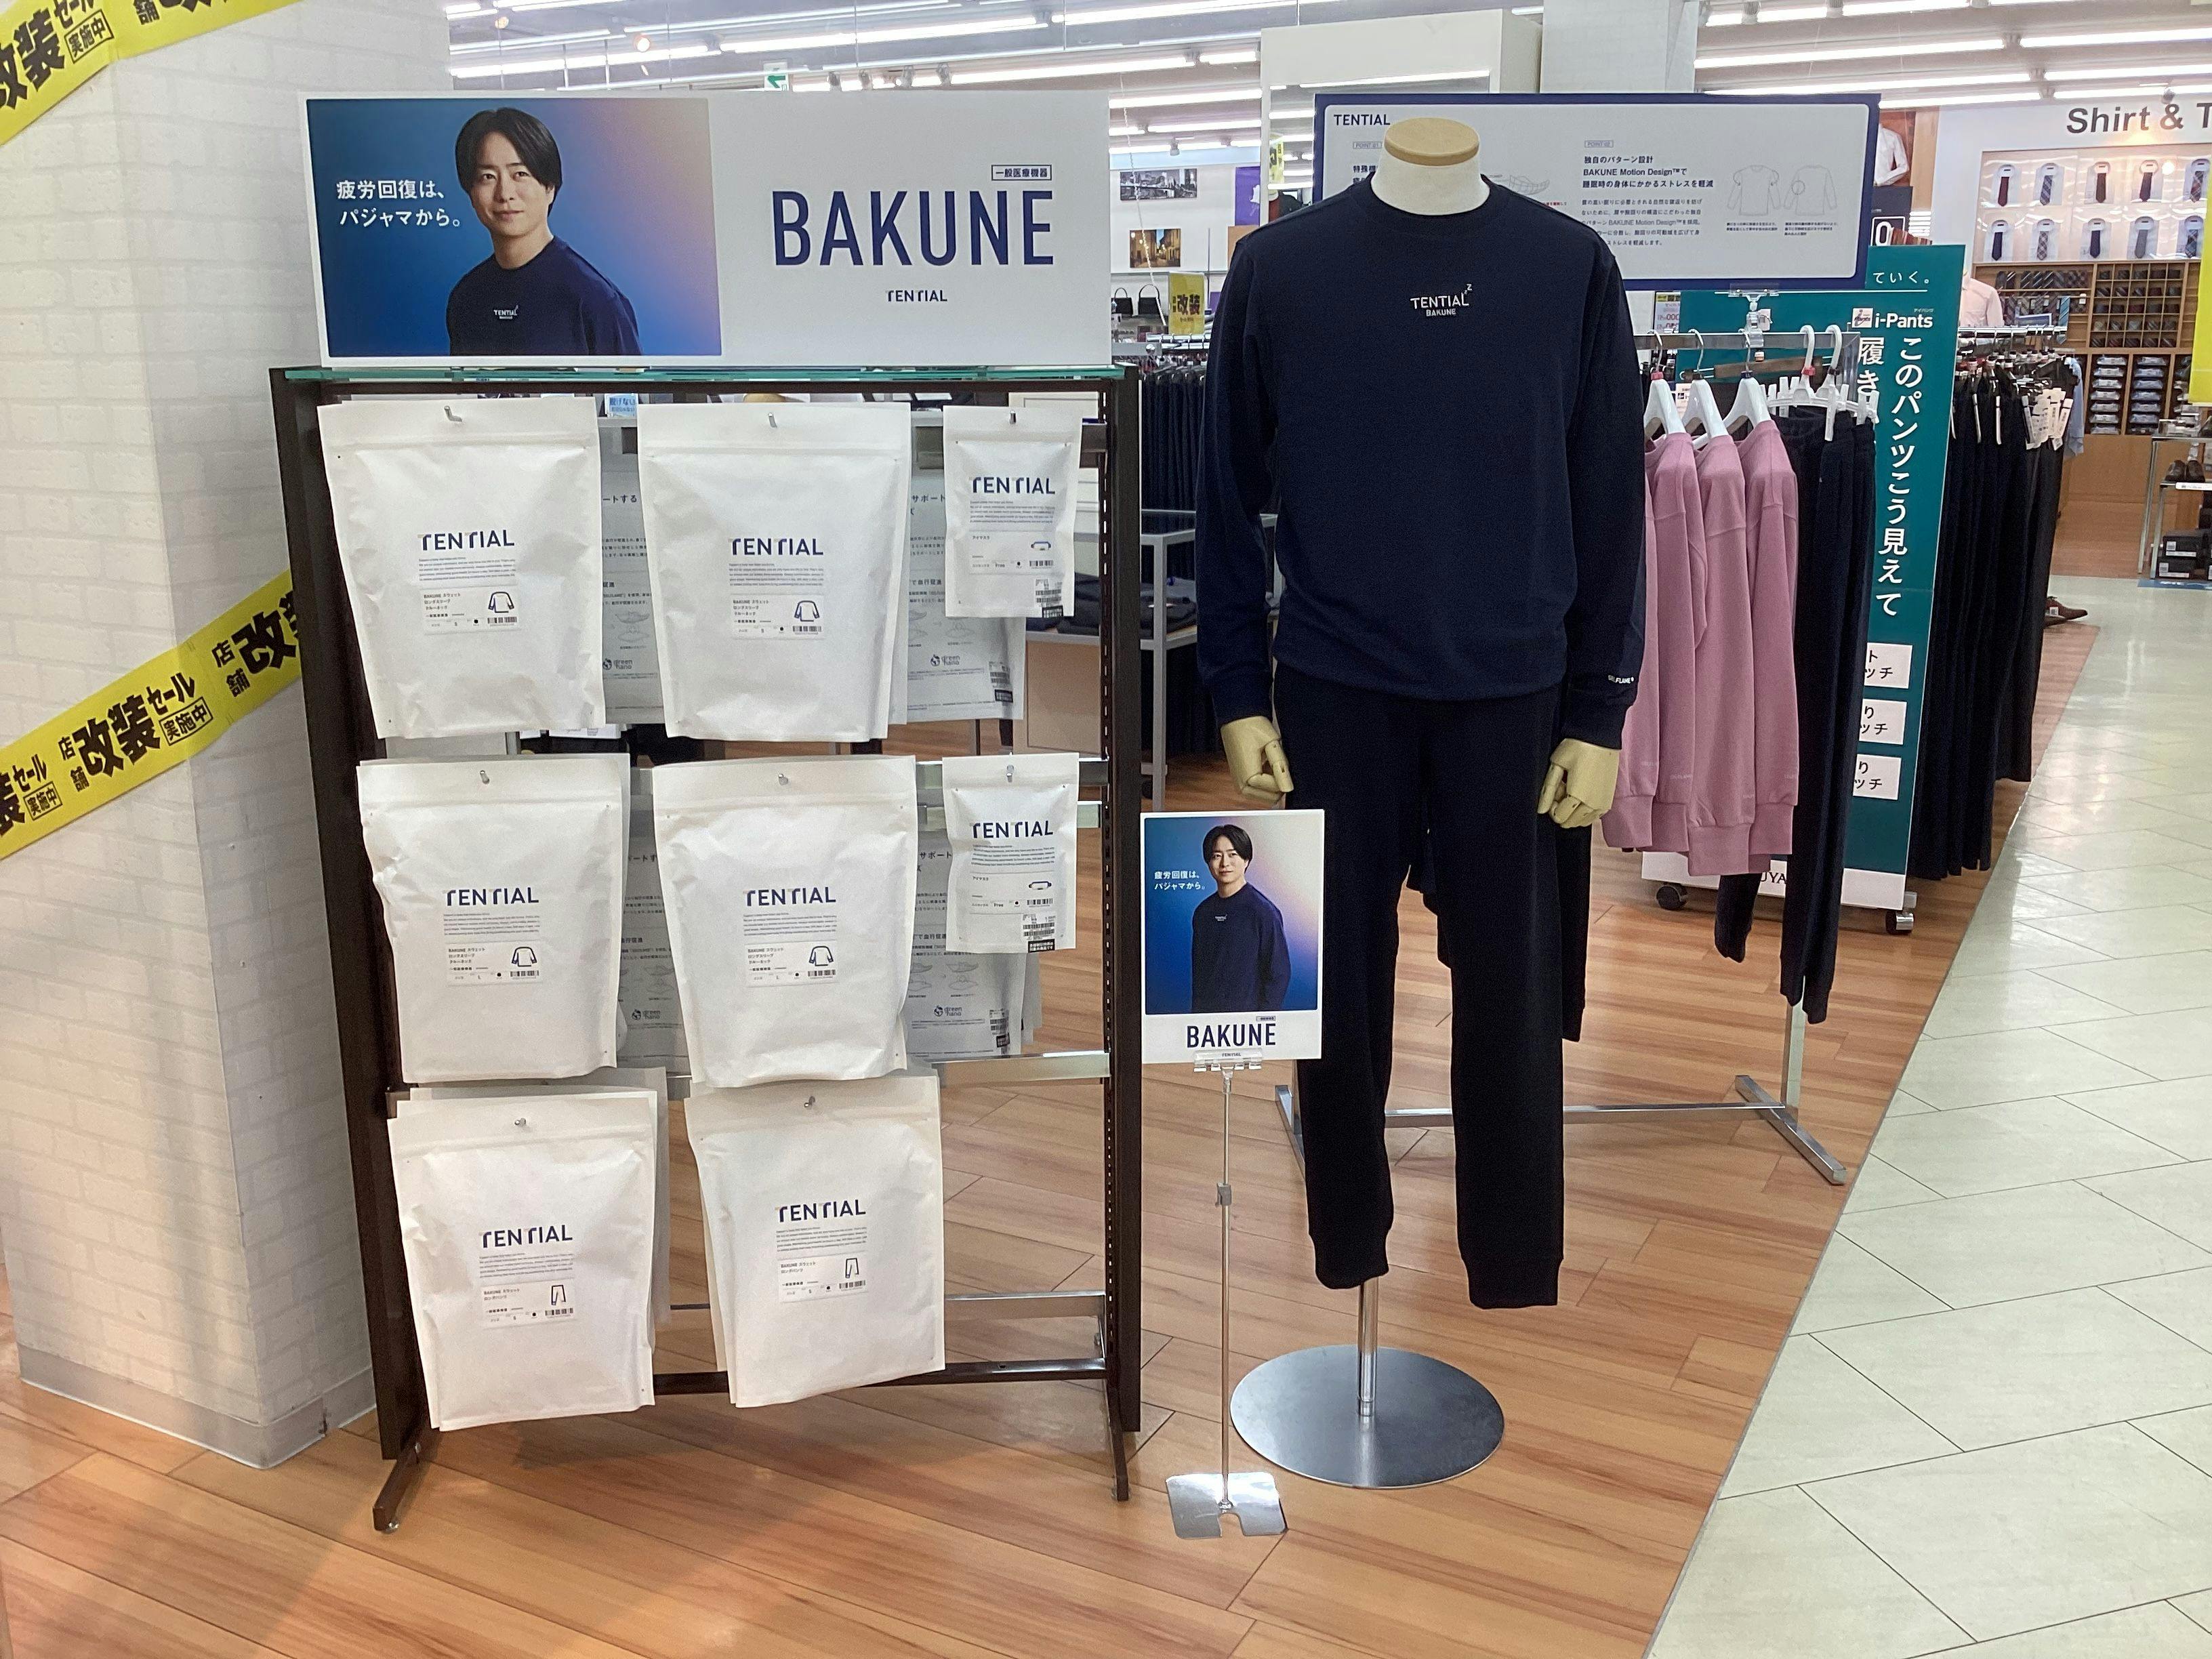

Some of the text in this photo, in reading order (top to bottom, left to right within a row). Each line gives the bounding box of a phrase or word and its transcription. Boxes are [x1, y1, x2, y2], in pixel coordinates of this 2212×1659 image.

[68, 18, 106, 58] 実施中
[1334, 113, 1391, 126] TENTIAL
[2066, 106, 2150, 134] Shirt
[2160, 104, 2185, 130] &
[1584, 156, 1654, 164] 独自のパターン設計
[1620, 168, 1645, 176] Motion
[336, 179, 445, 201] 疲労回復は、
[1582, 180, 1714, 188] 睡眠時の身体にかかるストレスを軽減
[339, 207, 461, 228] パジャマから。
[772, 190, 1054, 266] BAKUNE
[1873, 271, 1929, 285] ていく。
[885, 289, 947, 302] TENTIAL
[1410, 292, 1470, 310] TENTIAL
[1426, 308, 1456, 316] BAKUNE
[1875, 312, 1933, 328] i-Pants
[969, 476, 1055, 494] TENTIAL
[1875, 337, 1924, 617] このパンツこう見えて
[417, 529, 515, 551] TENTIAL
[729, 537, 824, 556] TENTIAL
[146, 672, 196, 716] セール
[162, 703, 209, 741] 実施中
[71, 694, 161, 778] 改装
[13, 754, 47, 793] セール
[970, 820, 1054, 838] TENTIAL
[1154, 871, 1200, 880] 疲労回復は、
[1154, 881, 1206, 890] パジャマから。
[443, 887, 539, 906] TENTIAL
[743, 886, 836, 907] TENTIAL
[1187, 1023, 1276, 1048] BAKUNE
[775, 1199, 866, 1223] TENTIAL
[478, 1224, 573, 1248] TENTIAL
